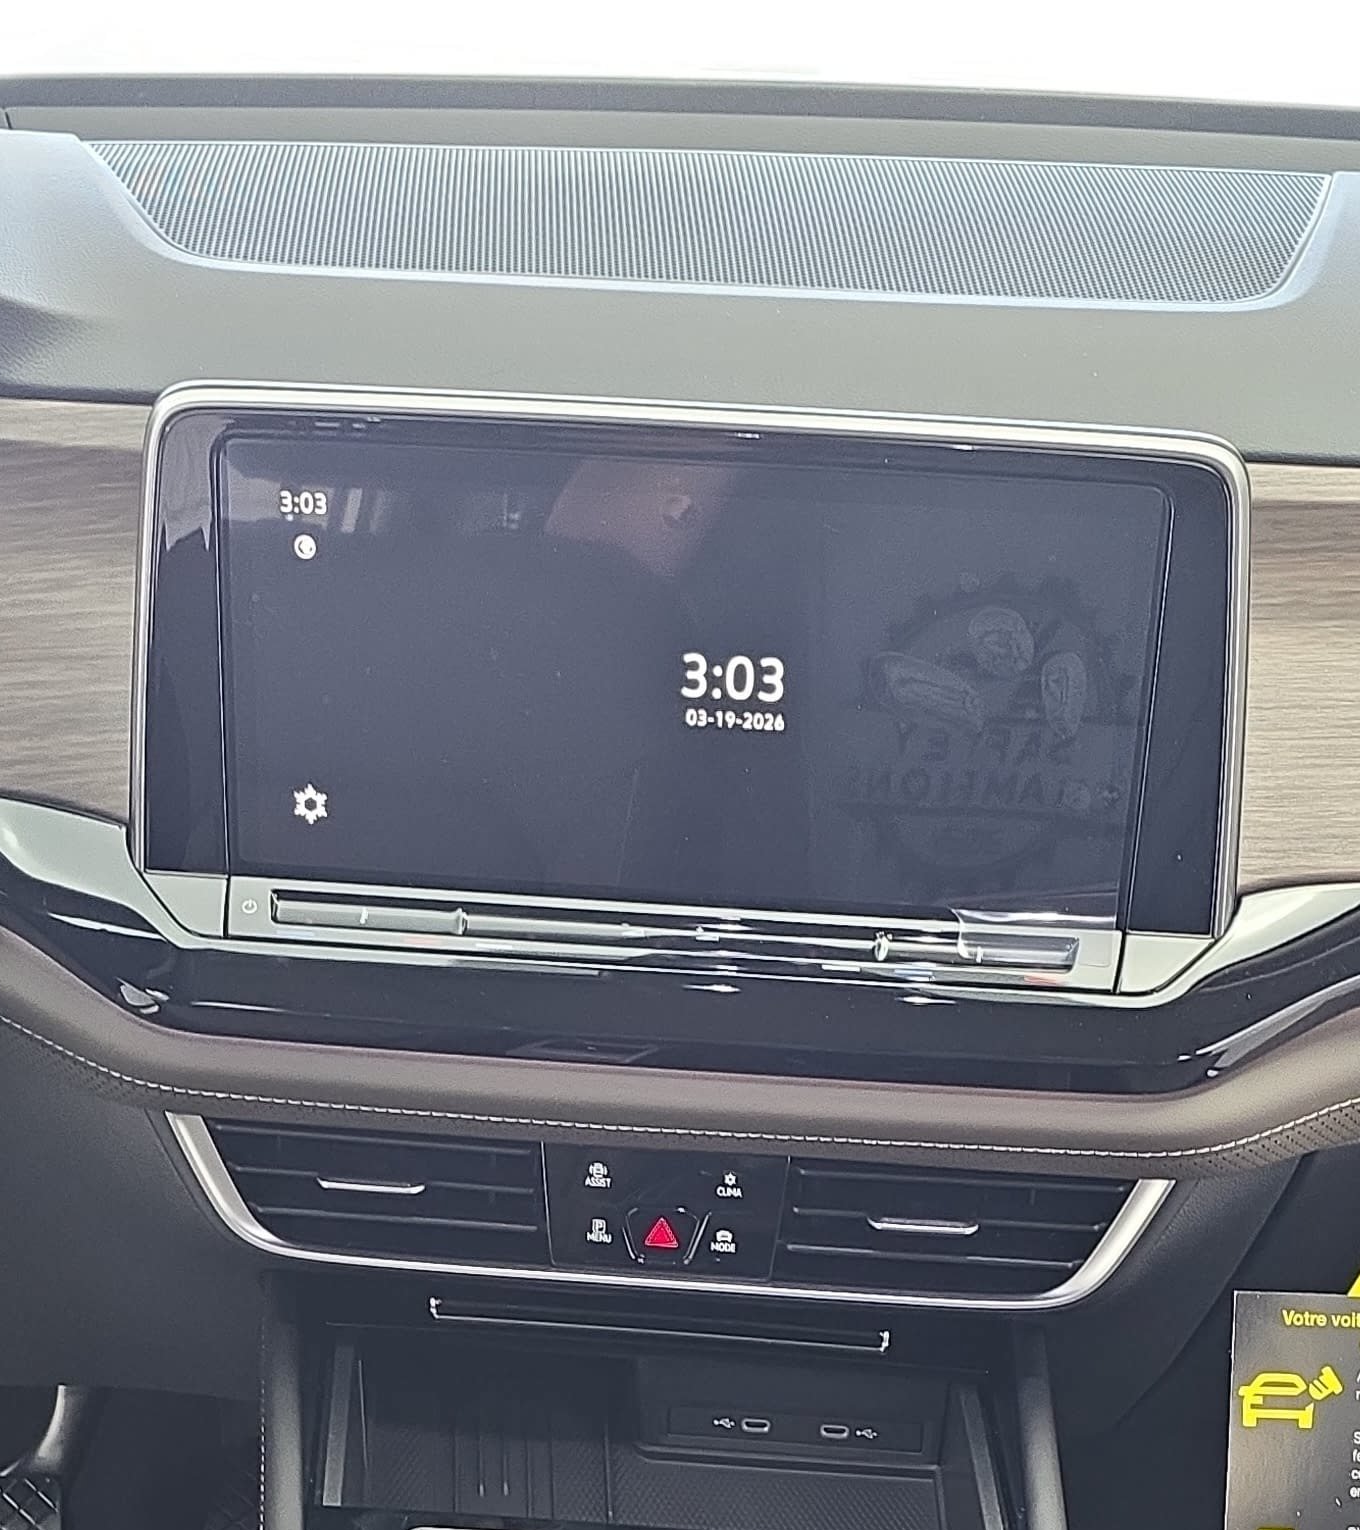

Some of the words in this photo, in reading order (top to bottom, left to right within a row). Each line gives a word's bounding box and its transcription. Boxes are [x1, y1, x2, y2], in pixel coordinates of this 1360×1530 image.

[280, 490, 327, 515] 3:03
[680, 652, 784, 702] 3:03
[685, 708, 785, 731] 03-19-2026
[585, 1177, 611, 1188] ASSIST
[586, 1232, 612, 1244] MENU
[710, 1241, 736, 1253] MODE
[1282, 1310, 1327, 1326] Votre
